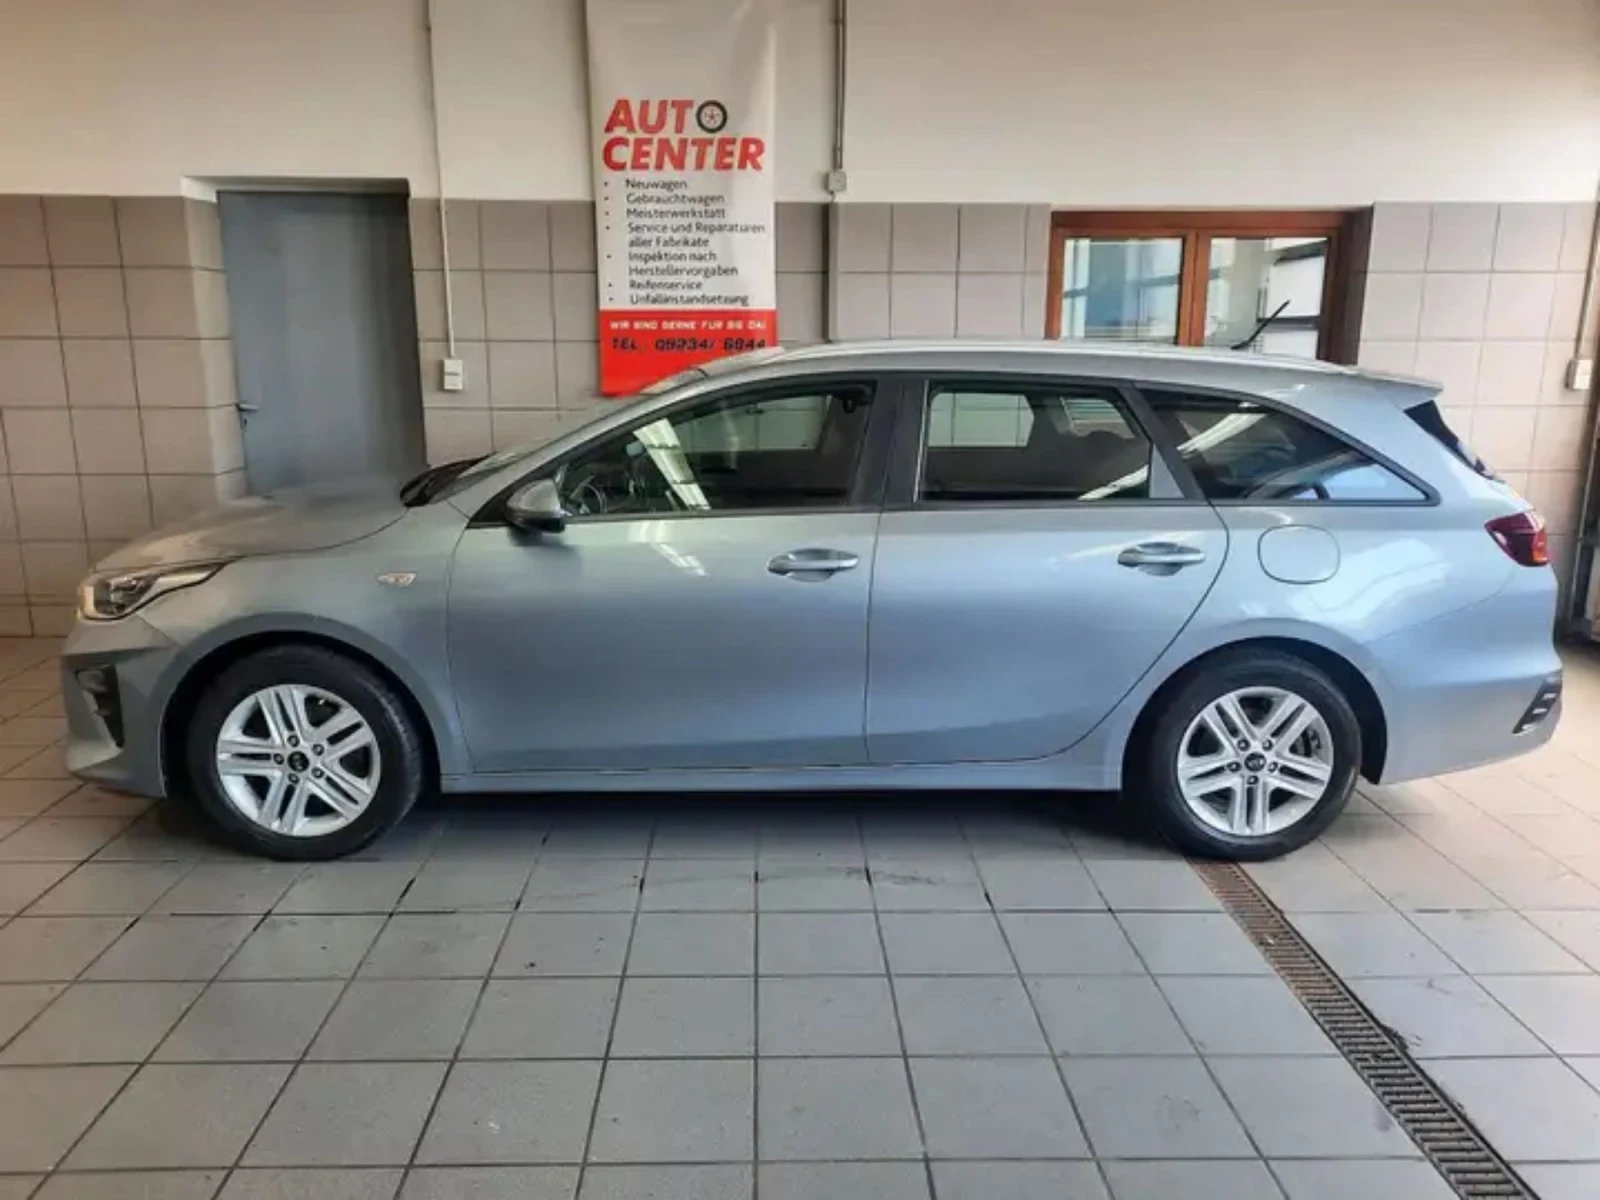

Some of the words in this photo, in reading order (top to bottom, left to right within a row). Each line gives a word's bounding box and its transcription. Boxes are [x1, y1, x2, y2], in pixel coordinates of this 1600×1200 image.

[602, 137, 765, 172] CENTER
[626, 179, 687, 191] Neuwagen
[626, 193, 725, 206] Gebrauchtwagen
[626, 208, 725, 219] Meisterwerkstatt
[628, 222, 668, 233] Service
[671, 222, 692, 233] und
[695, 222, 765, 235] Reparaturen
[628, 236, 652, 248] aller
[655, 236, 710, 248] Fabrikate
[628, 251, 687, 264] Inspektion
[689, 251, 717, 262] nach
[628, 265, 739, 278] Herstellervorgaben
[630, 279, 703, 290] Reifenservice
[630, 293, 750, 306] Unfallinstandsetzung
[610, 320, 630, 330] WIR
